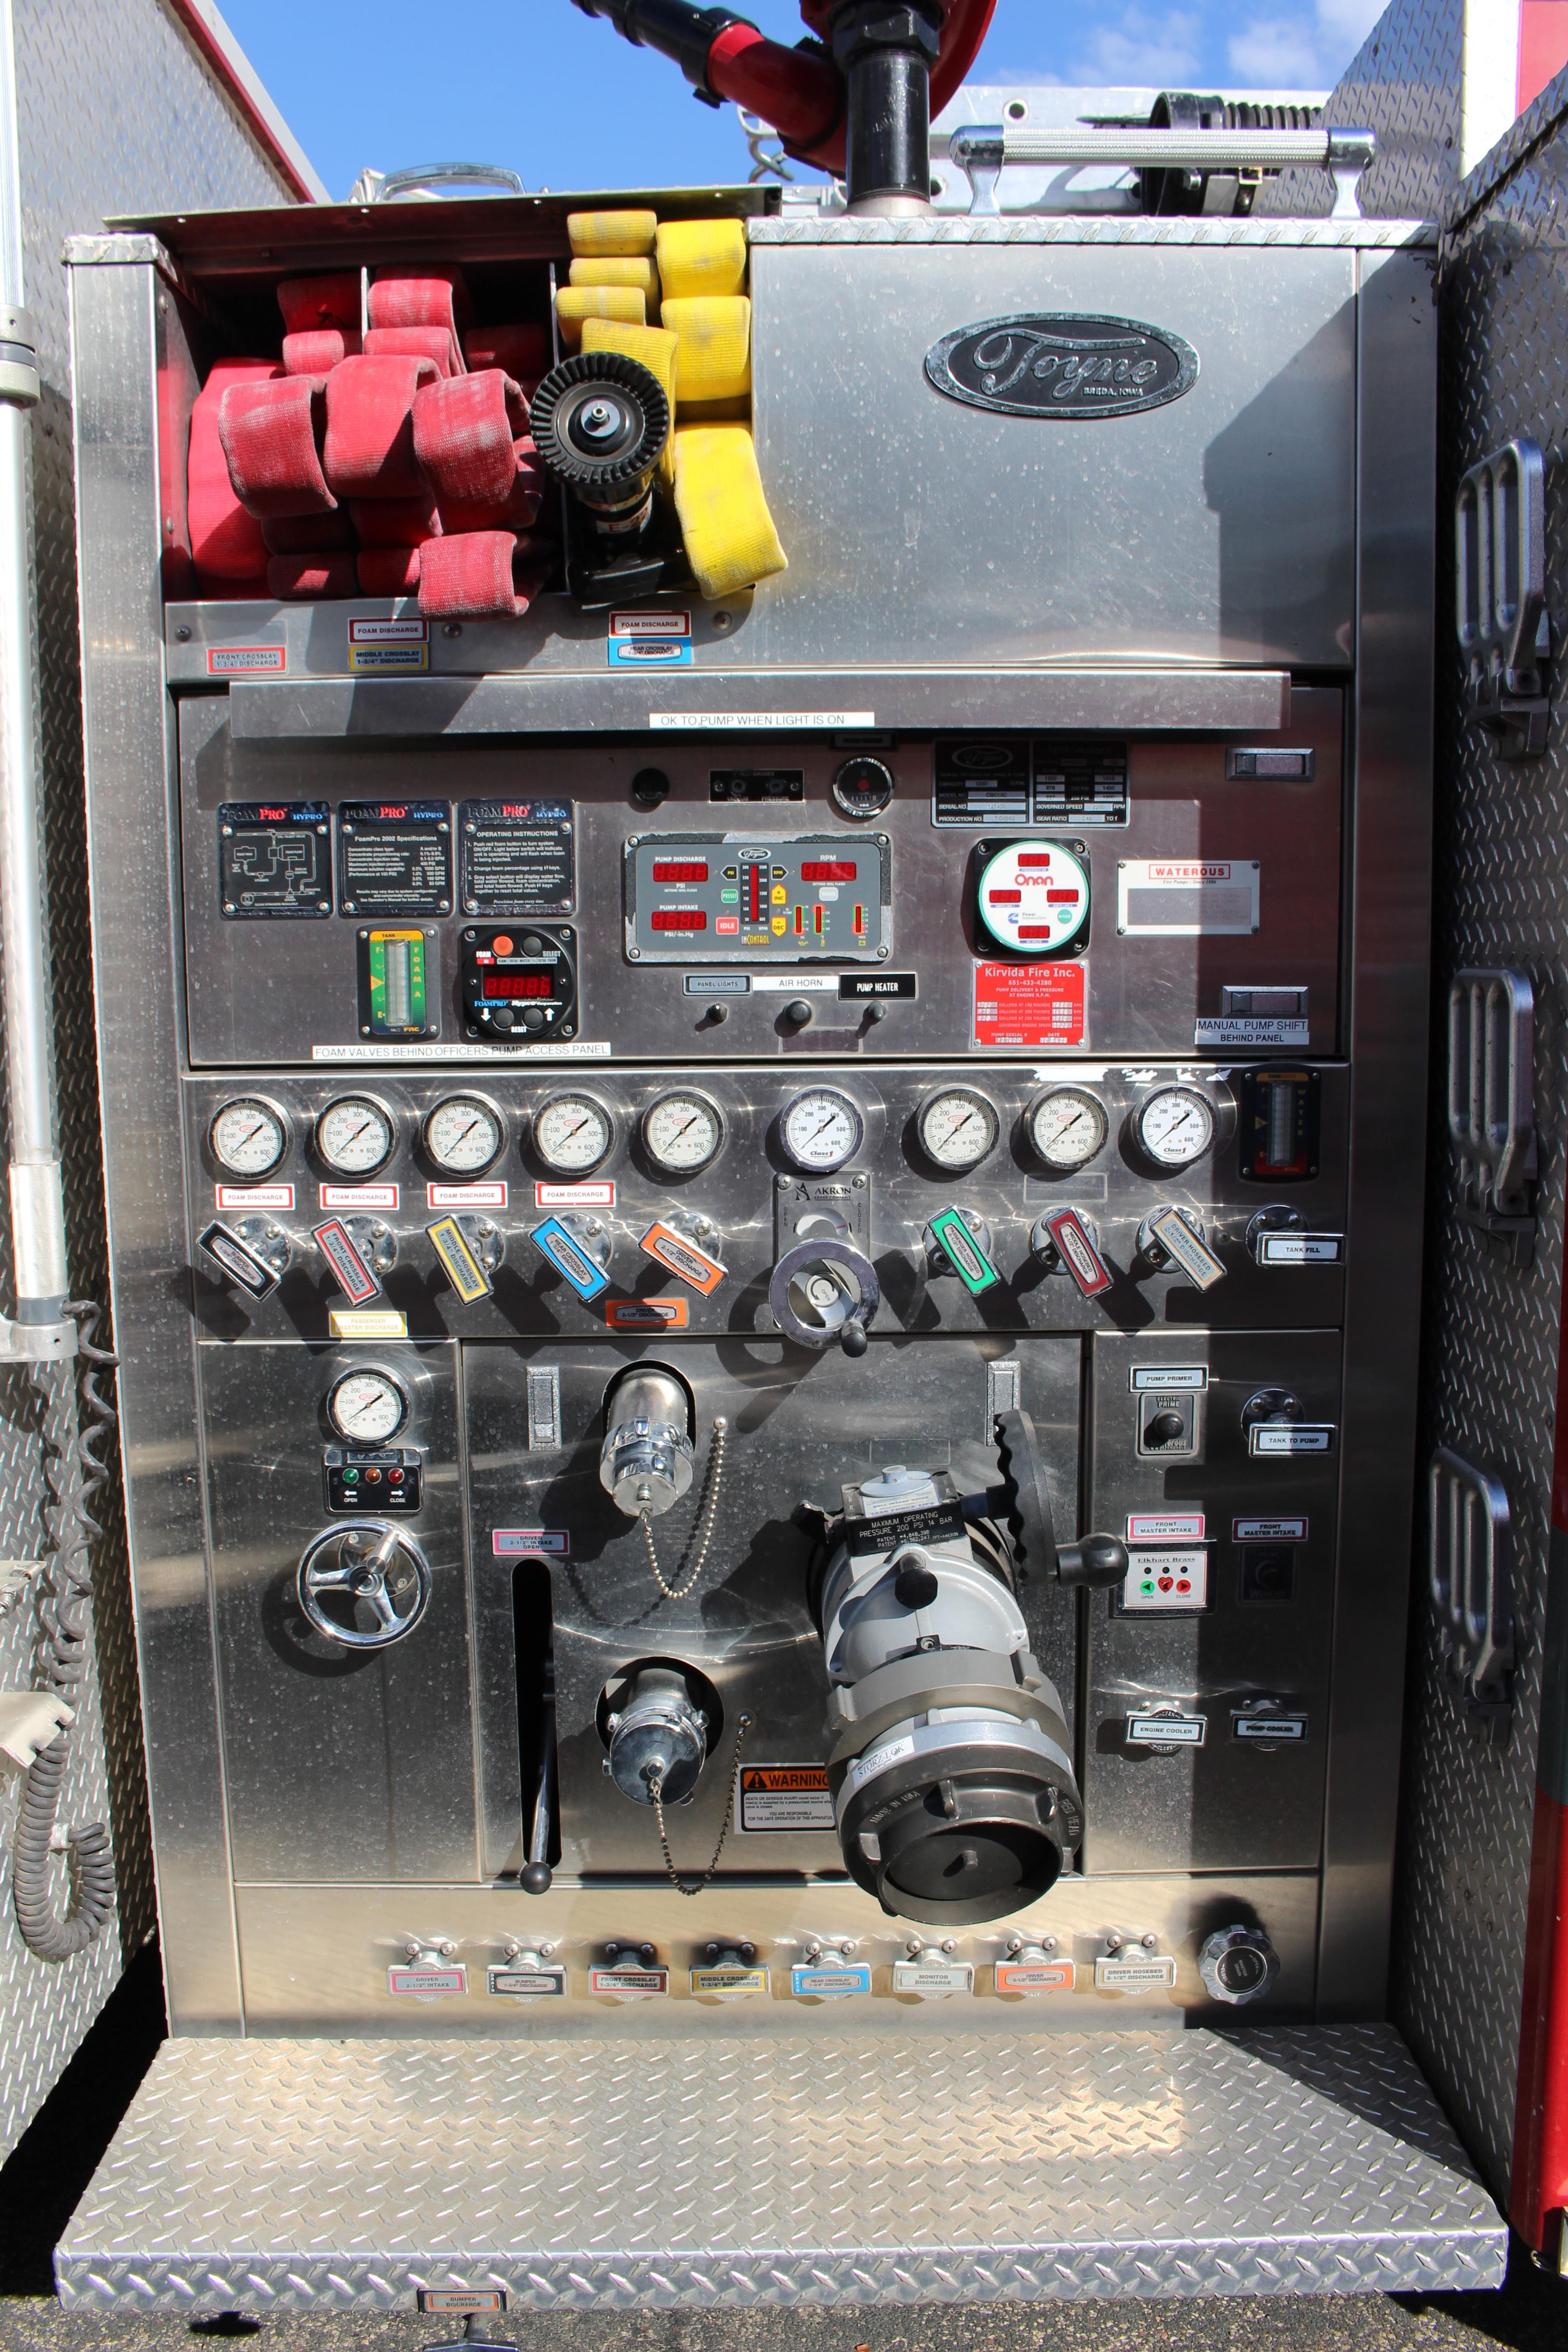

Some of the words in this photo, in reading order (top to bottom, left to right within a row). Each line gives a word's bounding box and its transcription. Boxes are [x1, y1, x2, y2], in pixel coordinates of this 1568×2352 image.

[973, 328, 1157, 399] Toyne
[1119, 387, 1143, 397] IOWA
[661, 716, 677, 725] OK
[682, 716, 697, 725] TO
[700, 716, 734, 725] PUMP
[737, 716, 773, 725] WHEN
[776, 716, 810, 725] LIGHT
[813, 715, 824, 725] IS
[827, 715, 844, 724] ON
[1014, 874, 1054, 886] Onan
[985, 967, 1024, 977] Kirvida
[1029, 967, 1050, 977] Fire
[1054, 967, 1075, 977] Inc.
[857, 983, 873, 991] PUMP
[875, 983, 898, 991] HEATER
[1198, 1021, 1241, 1030] MANUAL
[1244, 1021, 1274, 1030] PUMP
[1276, 1021, 1307, 1030] SHIFT
[316, 1048, 345, 1057] FOAM
[349, 1048, 390, 1057] VALVES
[393, 1047, 432, 1056] BEHIND
[435, 1046, 488, 1056] OFFICERS
[492, 1046, 522, 1055] PUMP
[525, 1046, 569, 1055] ACCESS
[573, 1045, 607, 1054] PANEL
[1171, 1224, 1189, 1244] DRIVER
[1188, 1244, 1210, 1271] HOSEBED
[332, 1233, 346, 1253] FRONT
[345, 1255, 365, 1286] CROSSLAY
[445, 1229, 461, 1254] MIDDLE
[459, 1255, 479, 1287] CROSSLAY
[338, 1256, 360, 1292] DISCHARGE
[451, 1254, 472, 1290] DISCHARGE
[860, 1527, 892, 1538] PRESSURE
[939, 1516, 953, 1525] BAR
[871, 1518, 900, 1528] MAXIMUM
[904, 1512, 938, 1523] OPERATING
